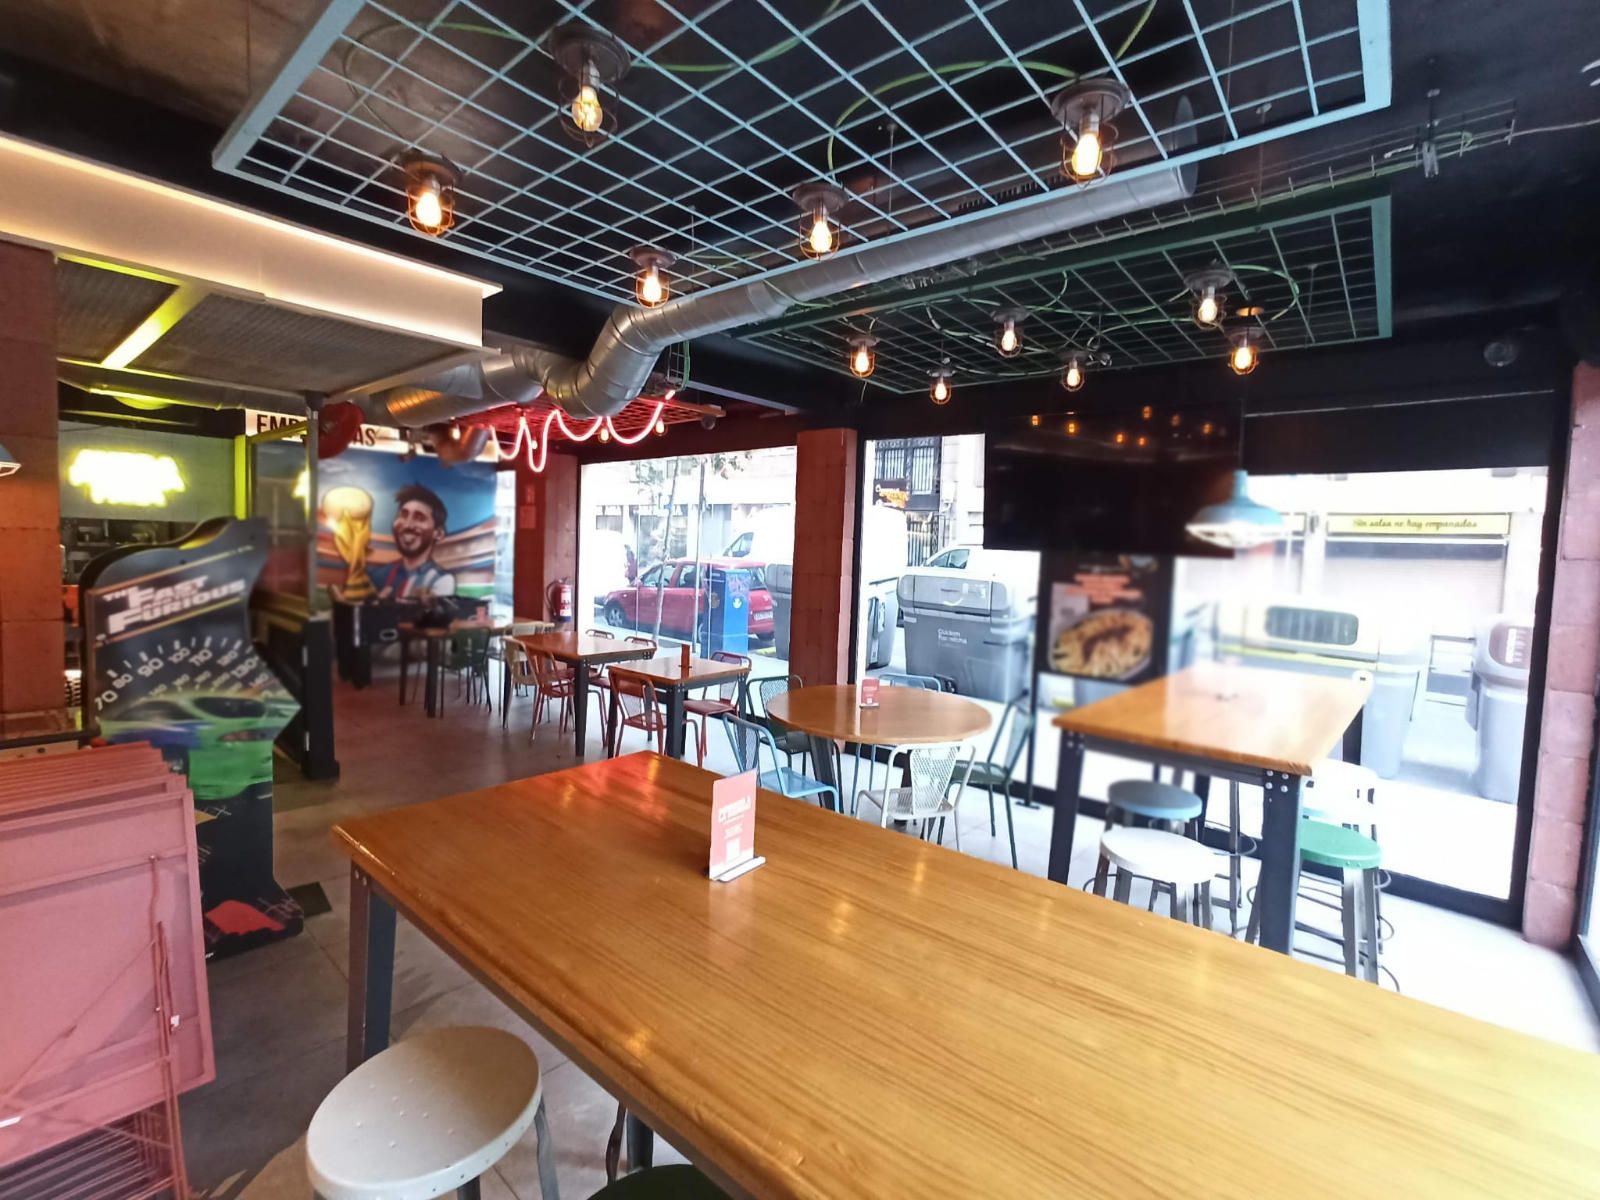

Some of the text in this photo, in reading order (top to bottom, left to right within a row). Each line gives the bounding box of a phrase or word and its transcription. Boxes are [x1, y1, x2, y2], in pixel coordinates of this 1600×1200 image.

[1369, 518, 1392, 527] salsa
[1406, 518, 1423, 530] hay
[1425, 518, 1477, 531] empanadas
[128, 575, 208, 609] FAST
[108, 579, 246, 634] FURIOUS
[168, 647, 190, 664] 100
[188, 649, 213, 667] 110
[137, 657, 163, 677] 90
[112, 673, 133, 689] 80
[95, 689, 119, 711] 70
